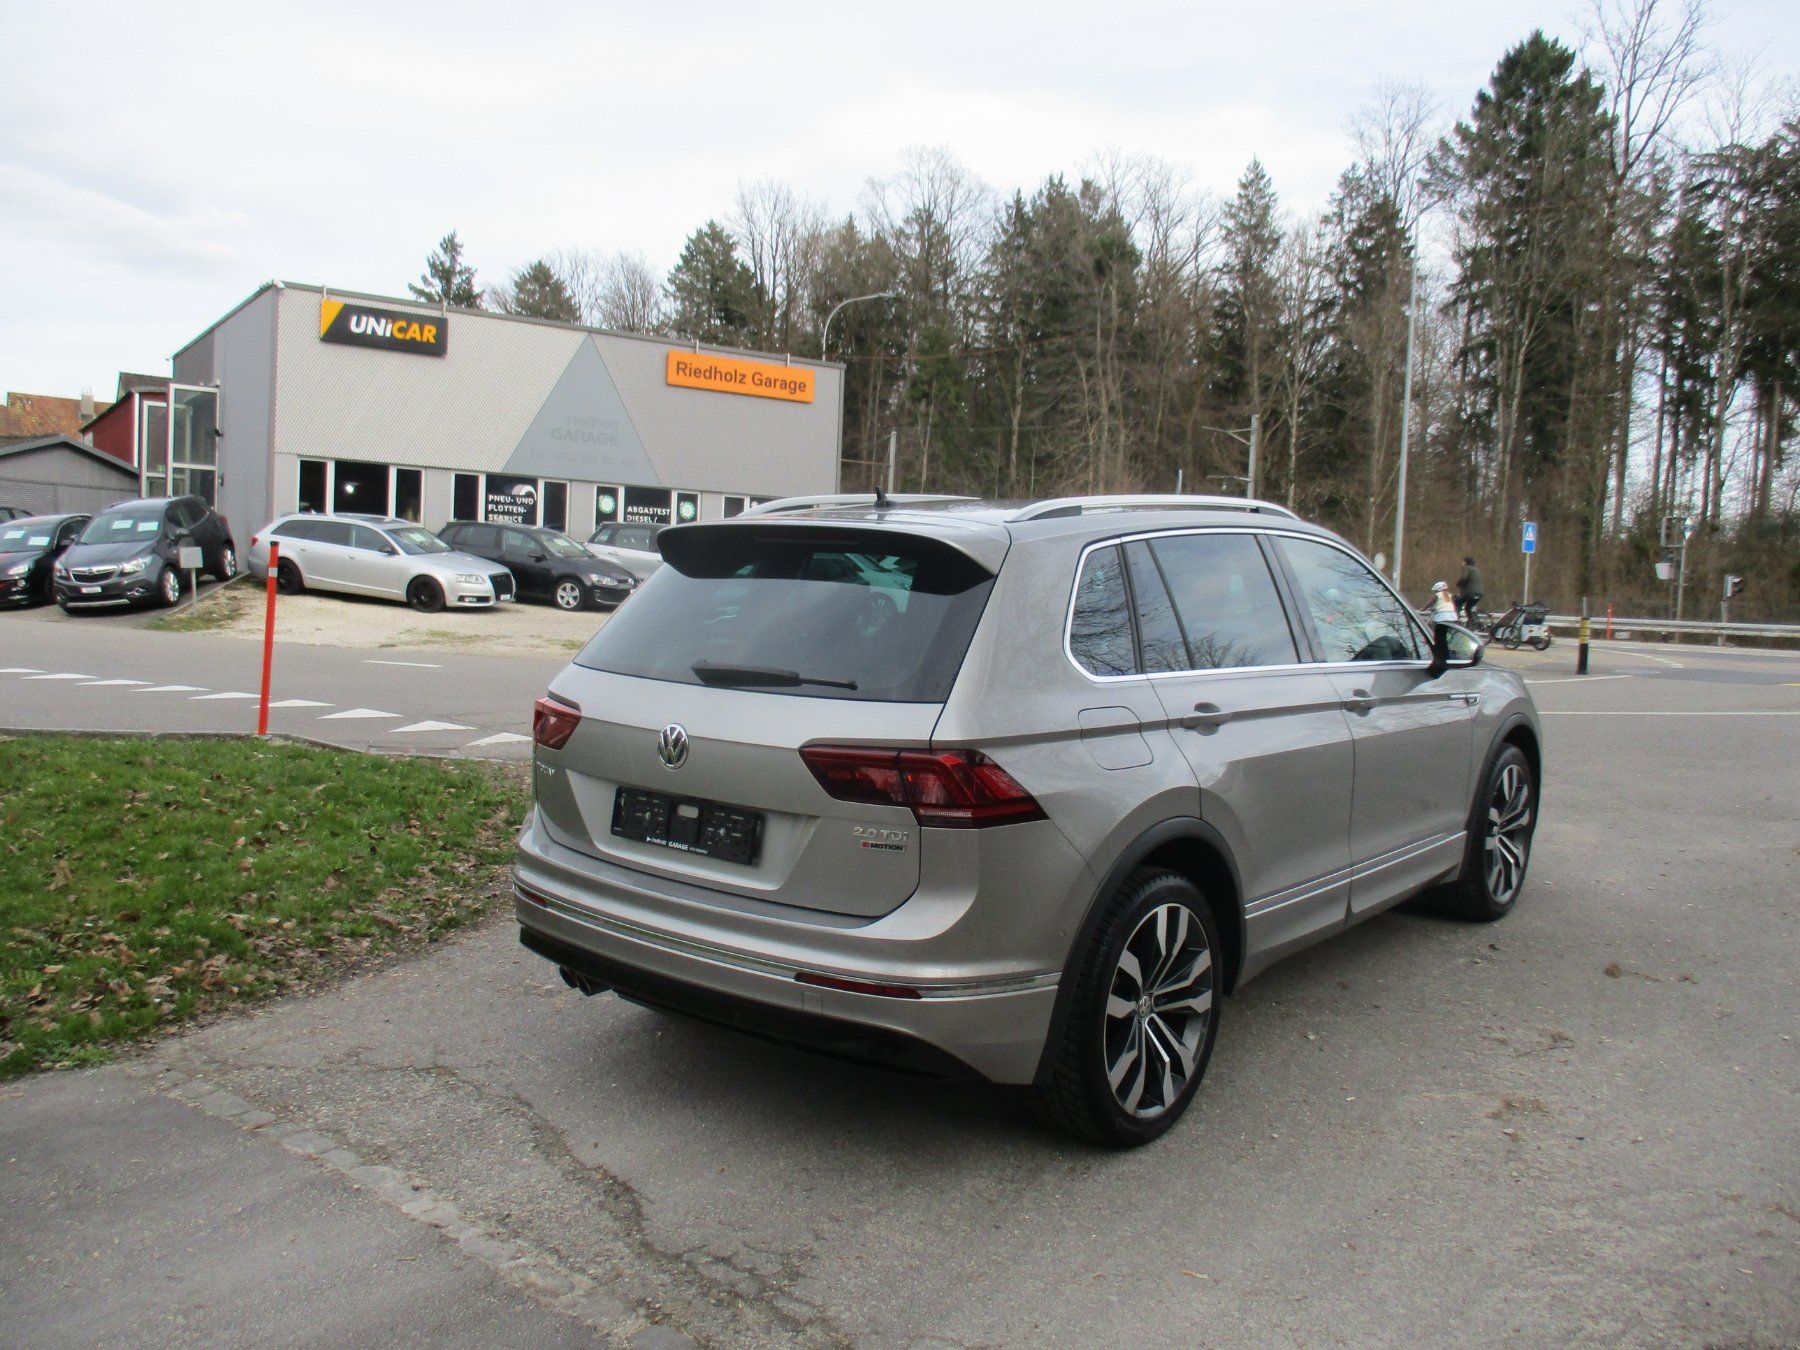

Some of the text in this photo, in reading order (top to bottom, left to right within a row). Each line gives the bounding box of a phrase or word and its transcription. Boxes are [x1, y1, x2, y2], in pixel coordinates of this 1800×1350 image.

[676, 361, 808, 395] Riedholz Garage
[550, 427, 619, 445] GARAGE
[488, 494, 534, 505] PNEU- UND
[488, 504, 527, 514] FLOTTEN-
[627, 505, 671, 516] ABGASTEST
[488, 514, 523, 523] SERVICE
[627, 515, 653, 523] DIESEL
[668, 840, 689, 851] GARAGE
